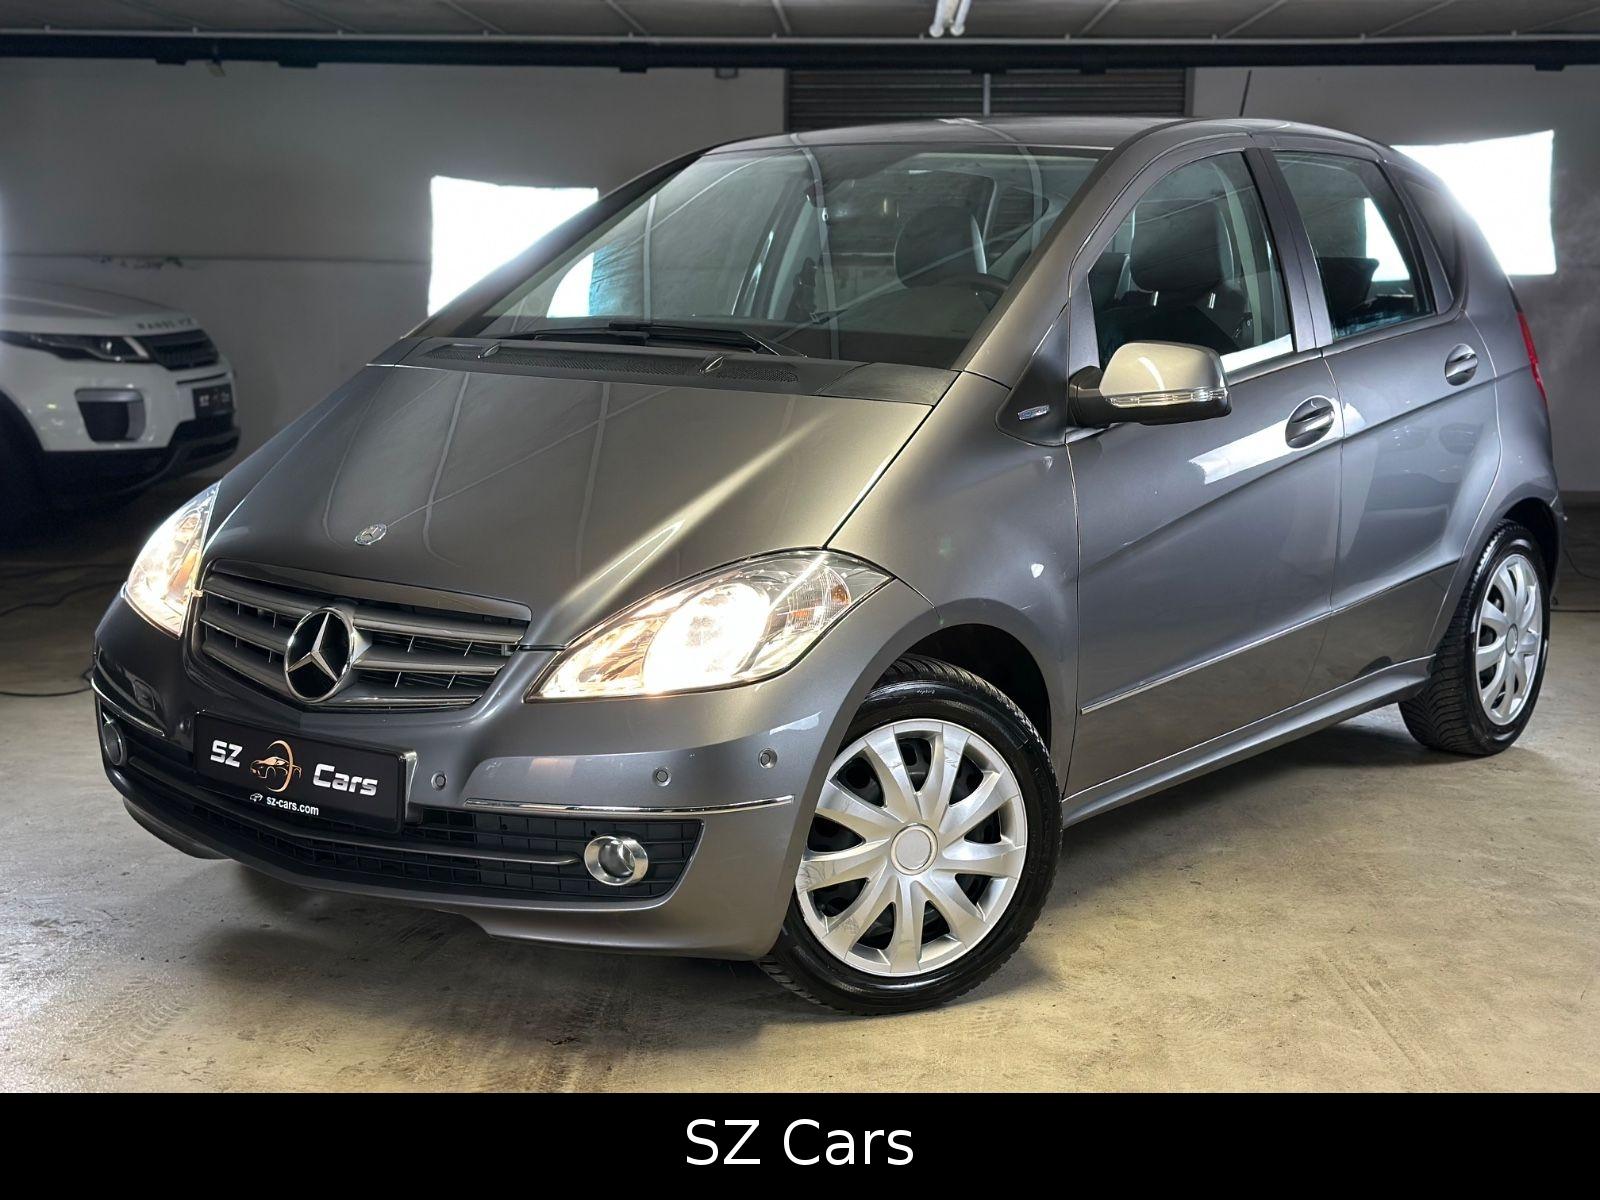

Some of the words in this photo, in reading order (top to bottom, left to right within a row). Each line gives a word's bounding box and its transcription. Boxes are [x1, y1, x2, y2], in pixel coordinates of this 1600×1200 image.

[210, 739, 243, 768] SZ
[312, 763, 378, 796] Cars
[266, 796, 319, 816] sz-cars.com
